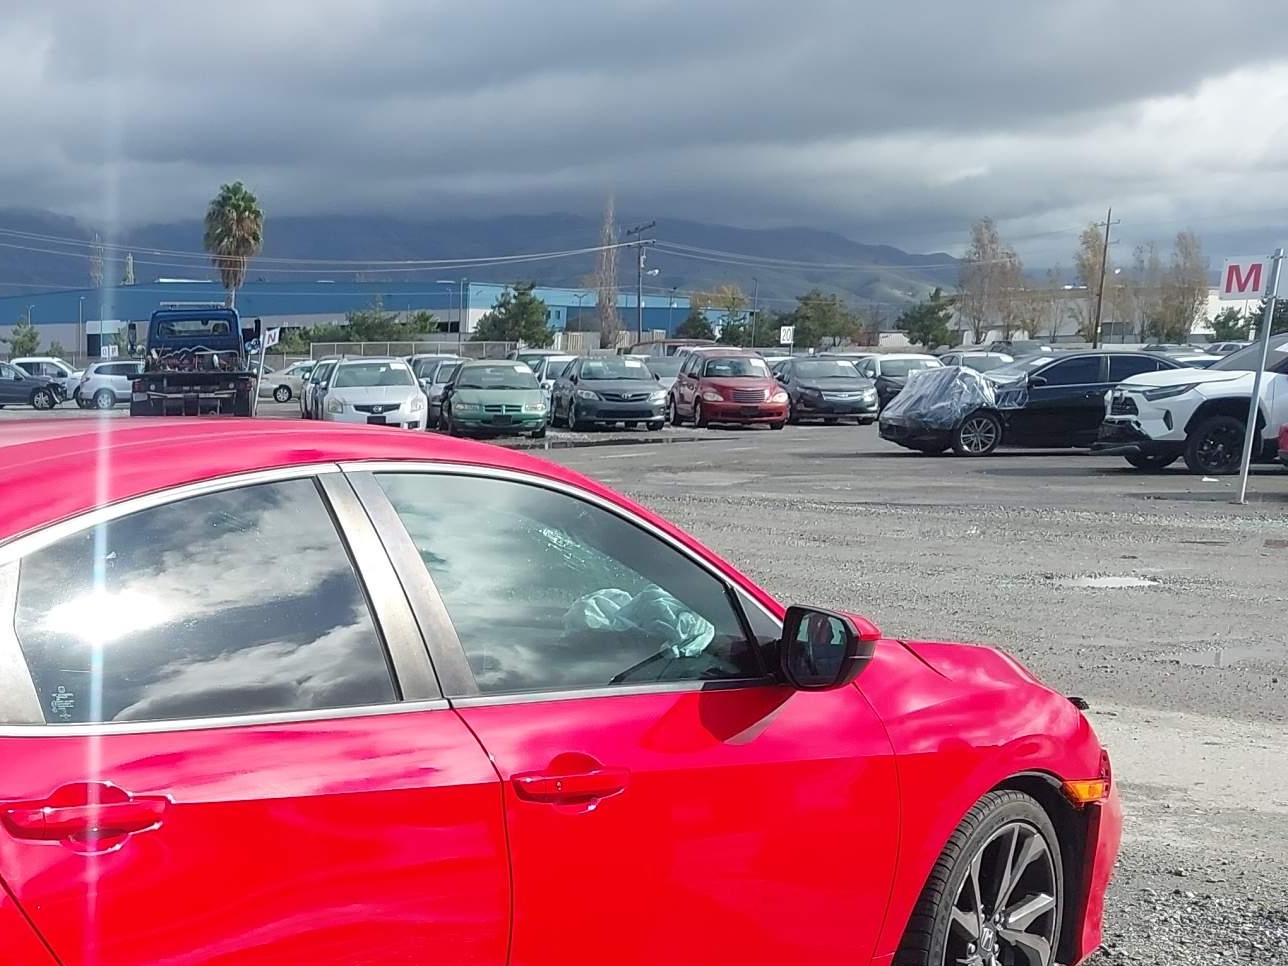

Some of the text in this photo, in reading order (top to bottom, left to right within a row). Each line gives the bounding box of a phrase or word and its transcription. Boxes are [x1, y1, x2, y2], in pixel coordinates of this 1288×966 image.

[1225, 263, 1262, 293] M
[267, 332, 277, 344] N
[782, 328, 792, 342] 20
